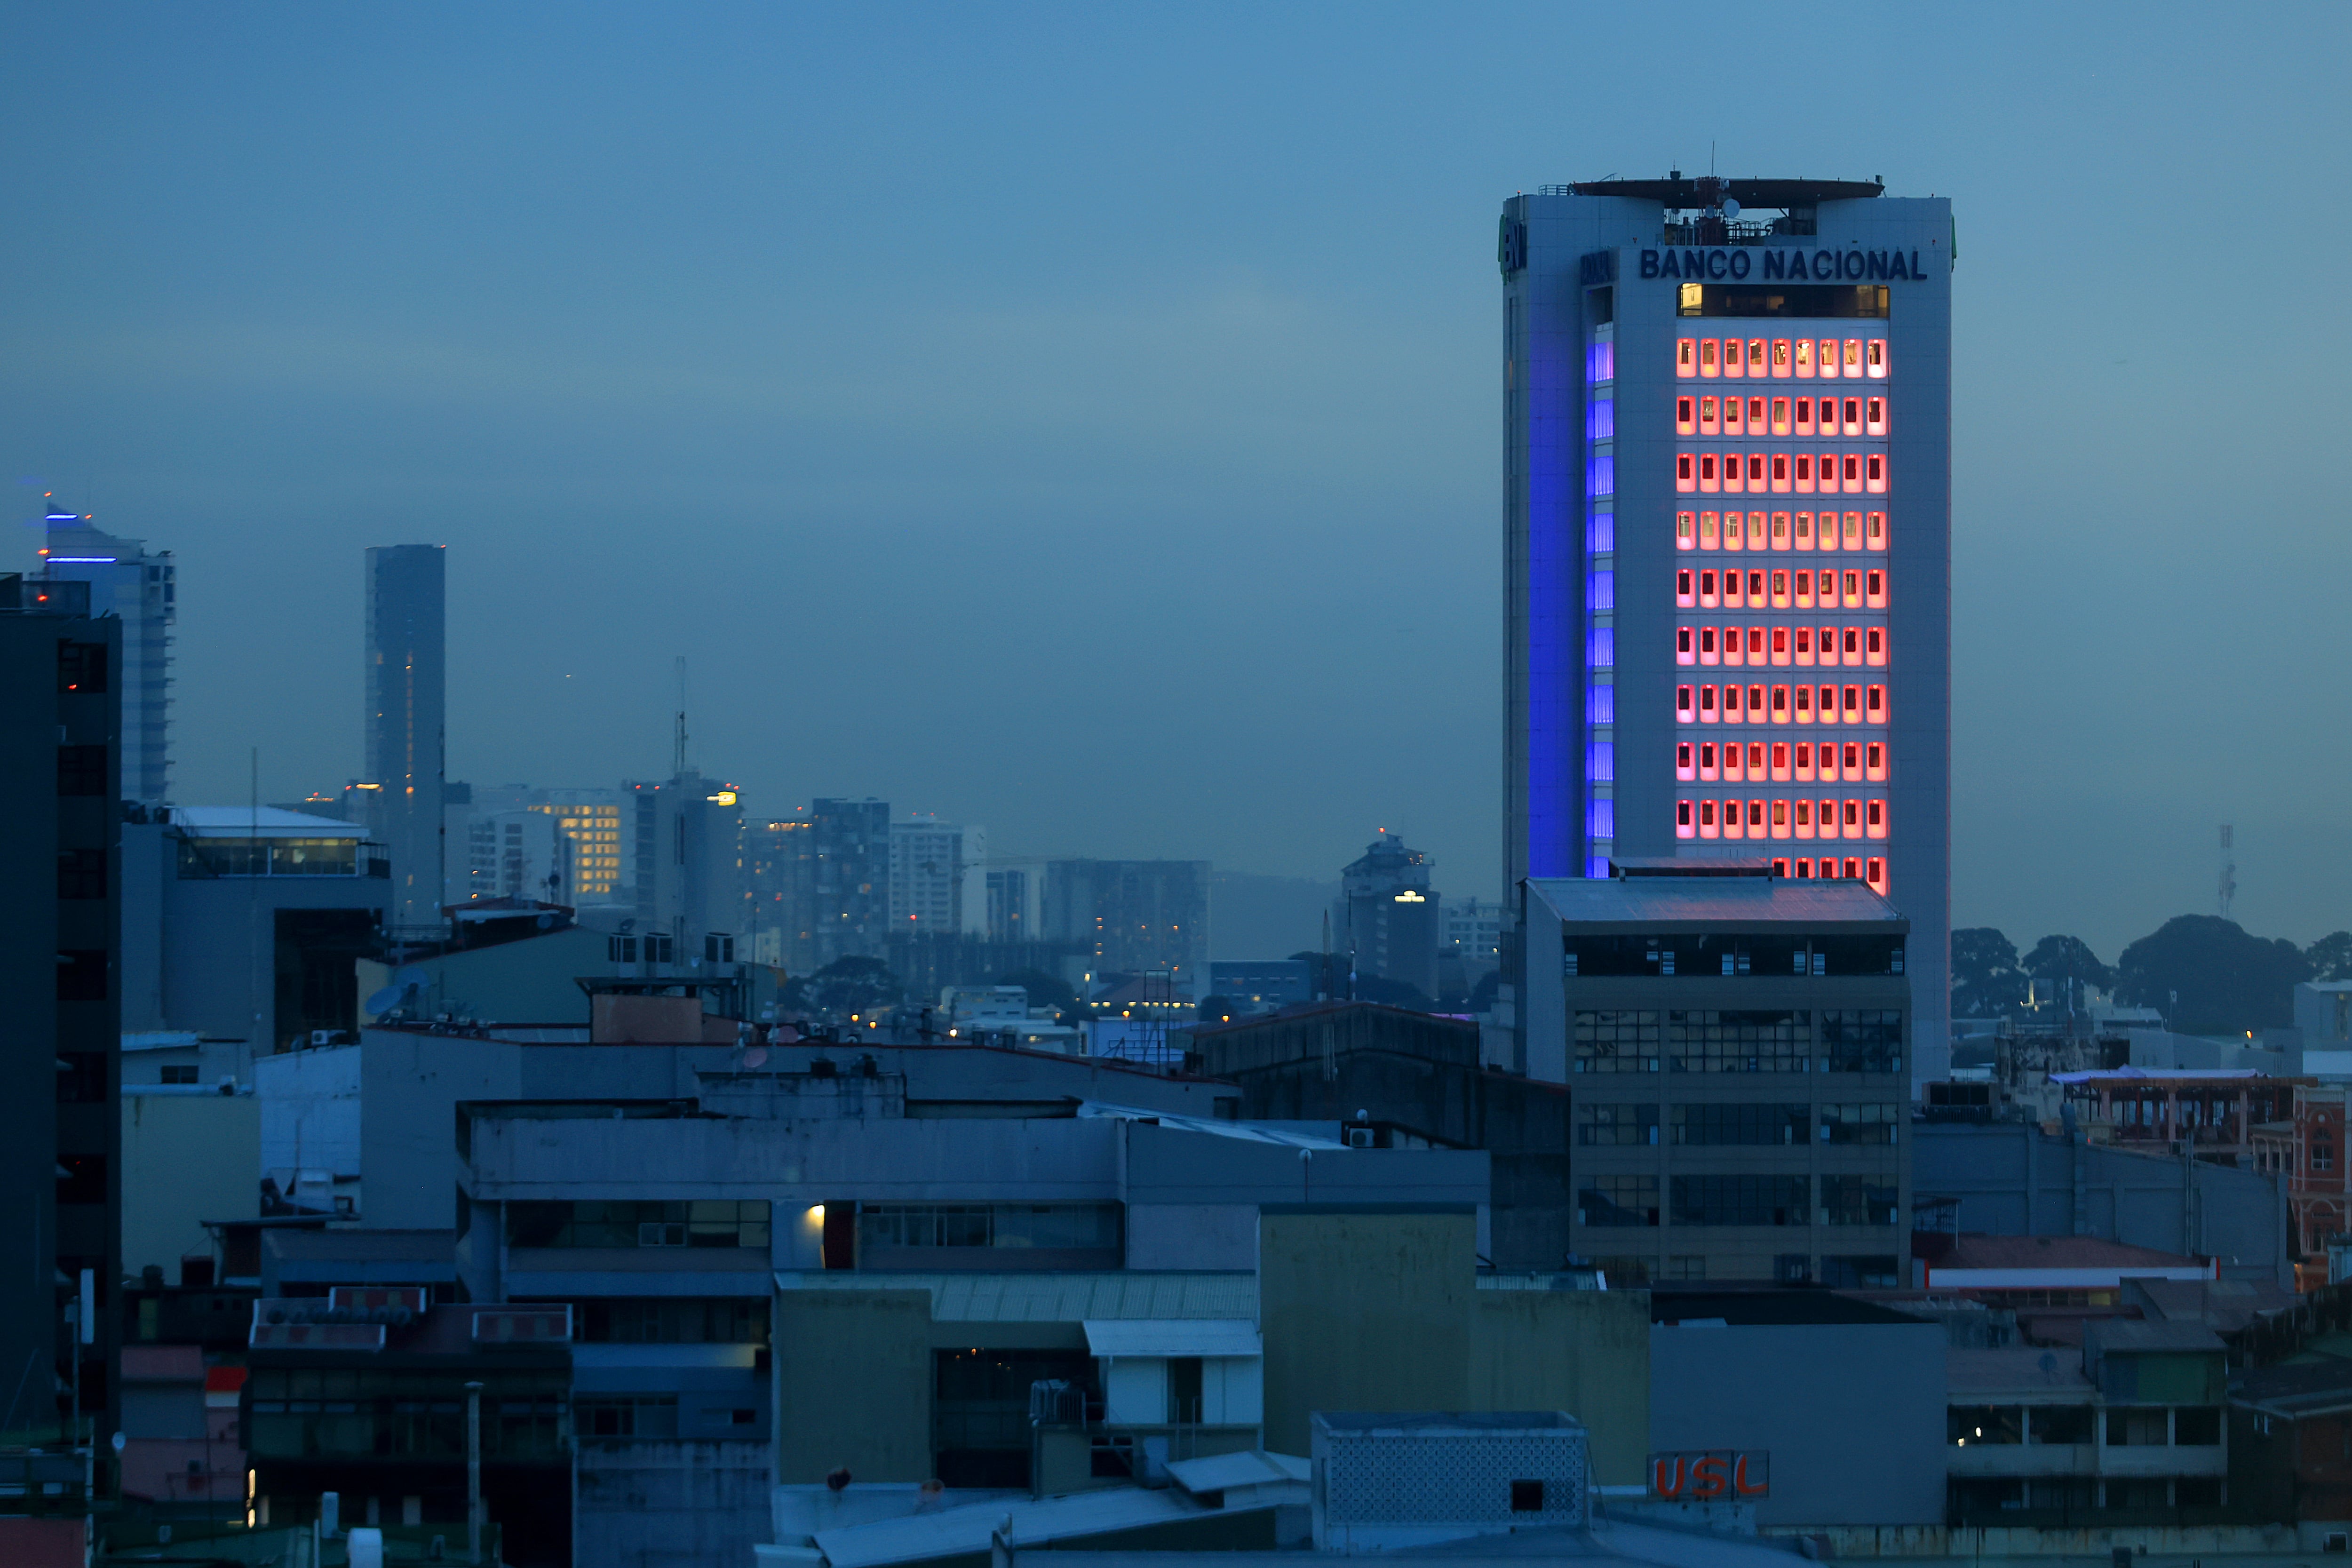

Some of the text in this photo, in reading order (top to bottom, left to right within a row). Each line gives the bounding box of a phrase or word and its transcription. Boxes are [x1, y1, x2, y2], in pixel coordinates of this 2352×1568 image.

[1641, 249, 1750, 279] BANCO
[1764, 250, 1927, 279] NACIONAL
[1654, 1454, 1768, 1496] USL
